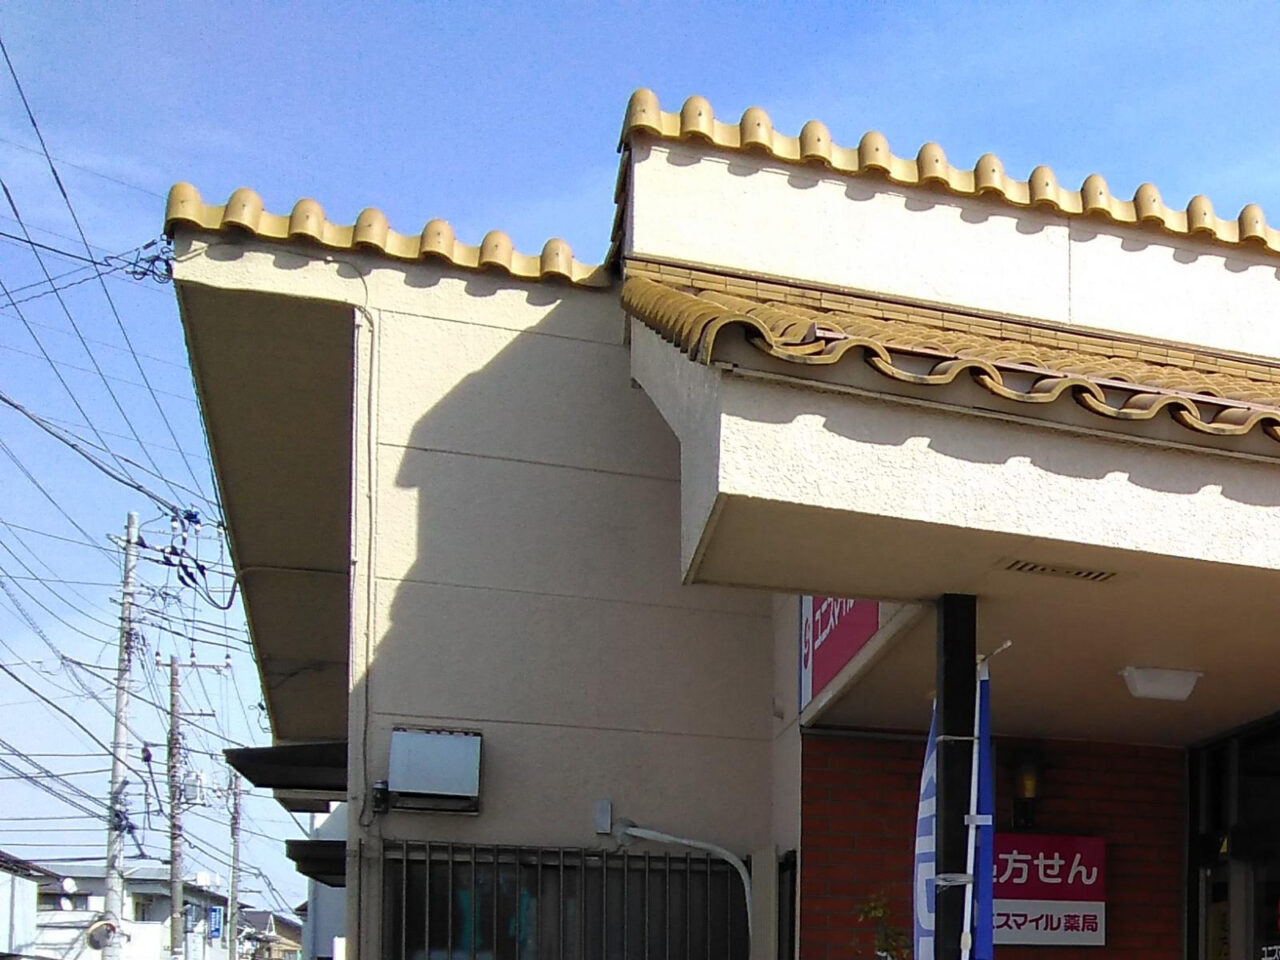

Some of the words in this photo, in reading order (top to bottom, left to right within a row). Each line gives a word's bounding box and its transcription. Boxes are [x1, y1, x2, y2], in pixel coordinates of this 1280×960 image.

[993, 849, 1098, 885] 方せん
[993, 912, 1099, 932] スマイル薬局
